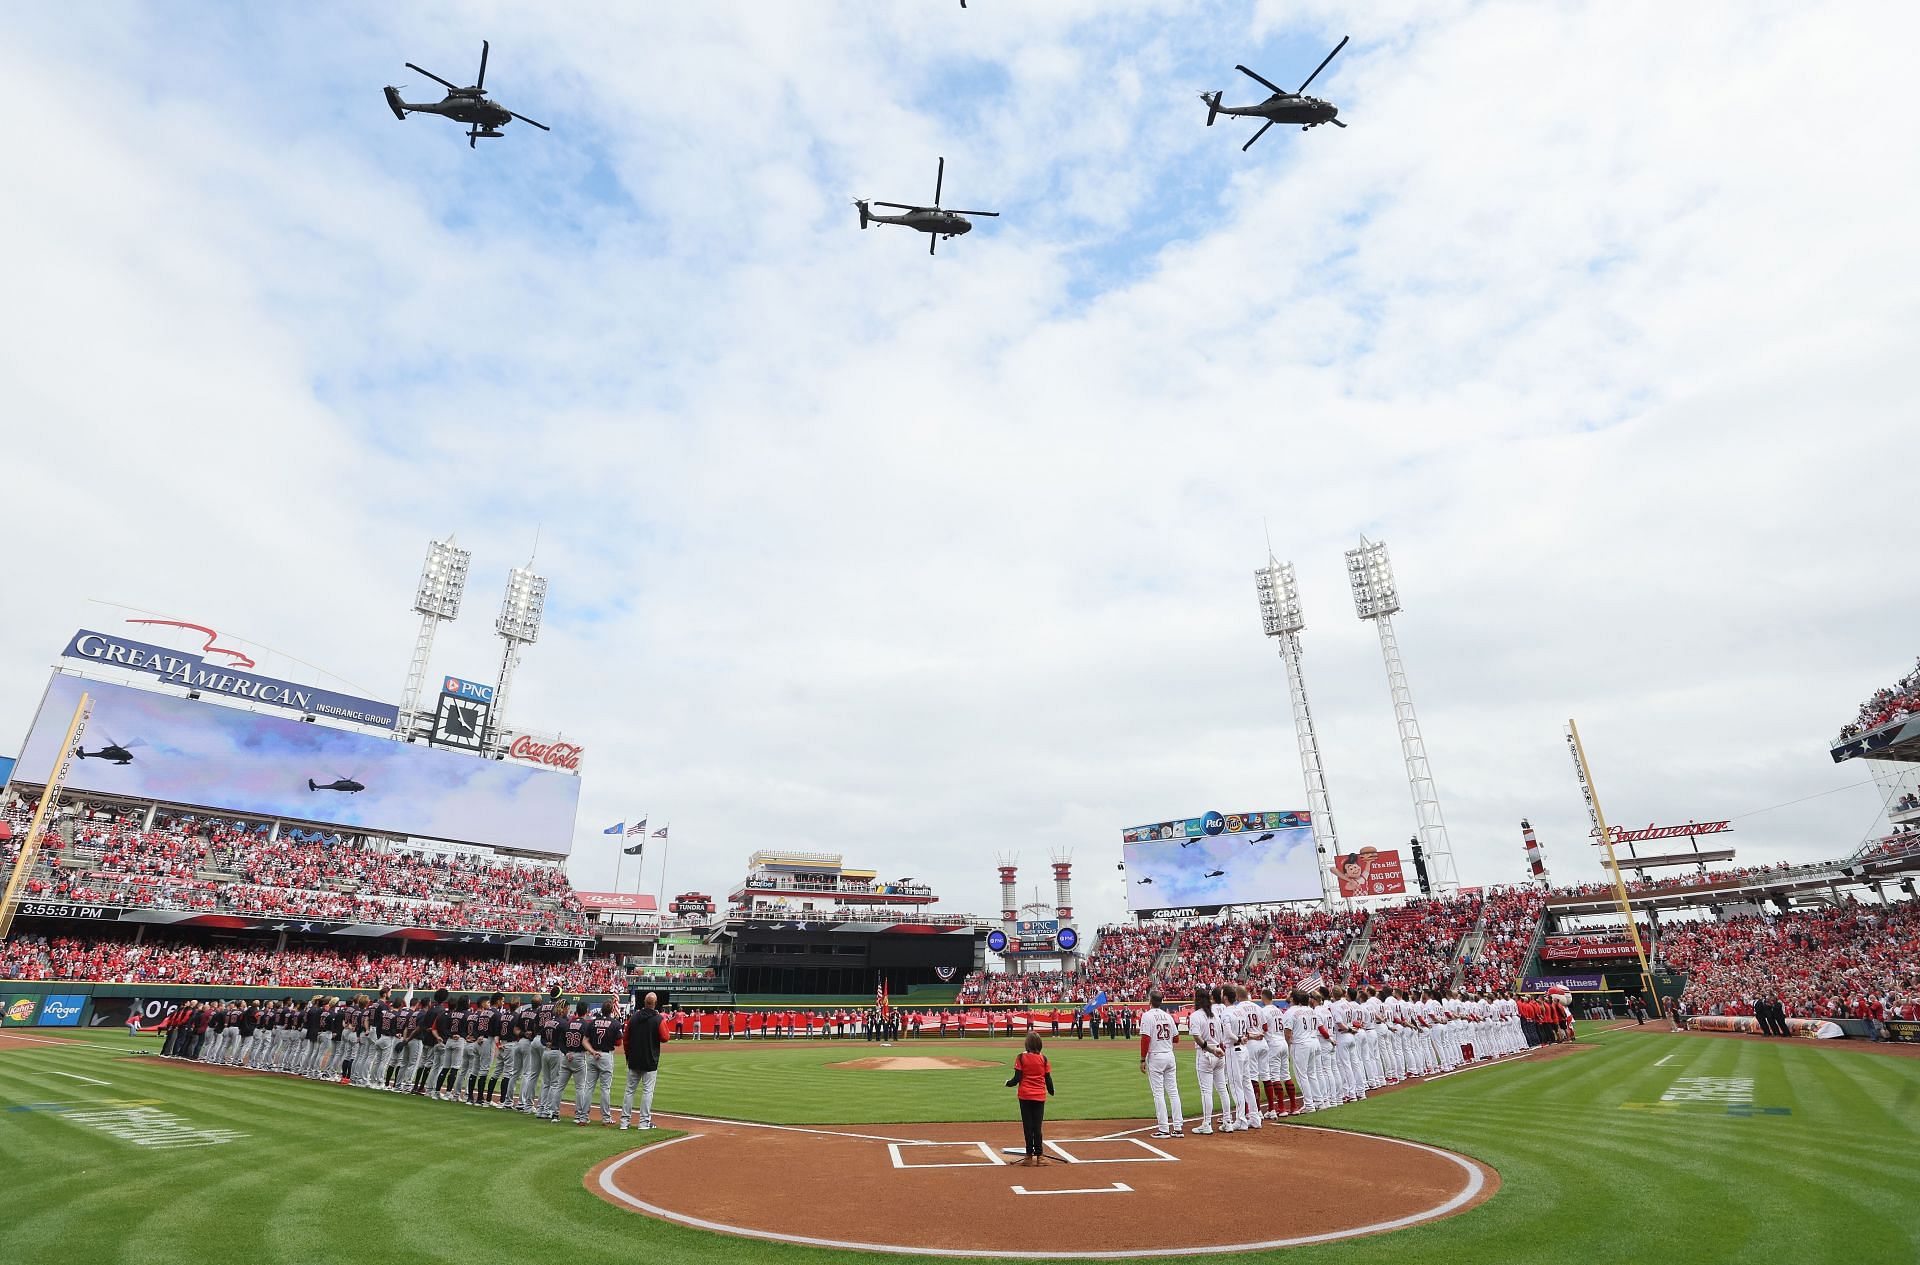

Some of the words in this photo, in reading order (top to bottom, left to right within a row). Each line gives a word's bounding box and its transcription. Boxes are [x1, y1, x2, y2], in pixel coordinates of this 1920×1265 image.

[76, 634, 183, 674] GREAT
[167, 662, 312, 708] AMERICAN
[462, 682, 492, 700] PNC
[316, 703, 363, 720] INSURANCE
[365, 713, 391, 725] GROUP
[1206, 818, 1222, 828] P&G
[1591, 820, 1728, 845] Budweiser
[905, 887, 931, 895] TriHealth
[23, 903, 76, 917] 3:55:51
[80, 906, 103, 919] PM
[1157, 908, 1196, 918] GRAVITY
[1032, 921, 1051, 930] PNC
[545, 938, 572, 947] 3:55:51
[574, 940, 586, 948] PM
[1535, 979, 1564, 990] planet
[1565, 978, 1598, 987] fitness
[44, 1001, 81, 1019] Kroger
[1247, 1013, 1258, 1029] 19
[1274, 1018, 1284, 1033] 15
[596, 1028, 606, 1045] 7
[1156, 1023, 1170, 1041] 25
[1209, 1022, 1215, 1038] 6
